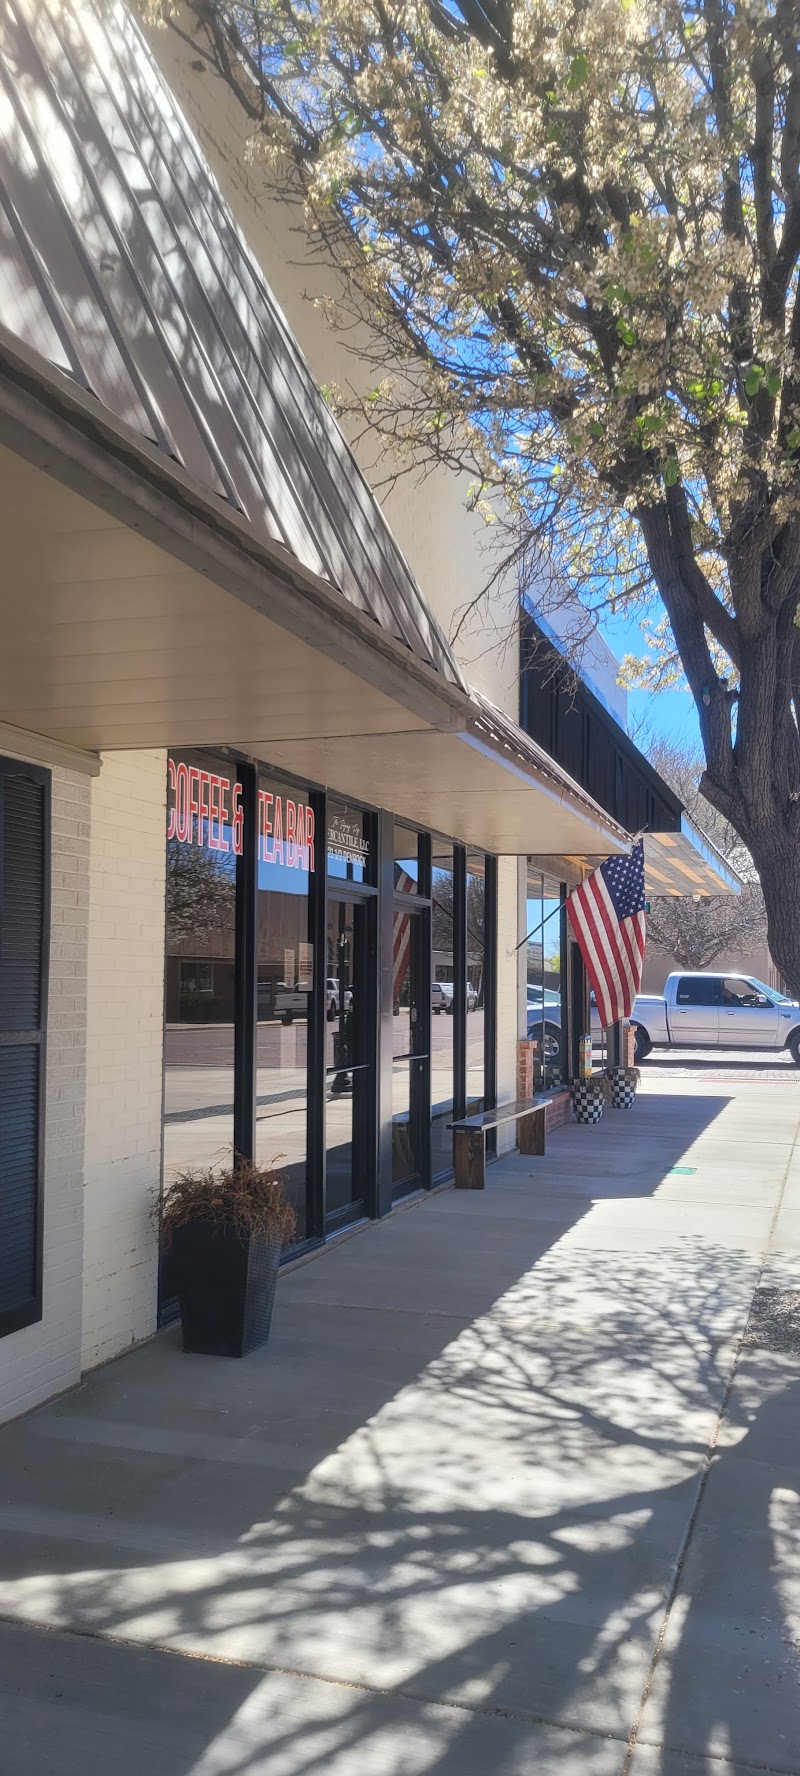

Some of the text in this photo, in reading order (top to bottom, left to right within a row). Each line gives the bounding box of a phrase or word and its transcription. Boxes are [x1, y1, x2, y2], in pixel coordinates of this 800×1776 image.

[167, 758, 230, 852] COFFEE
[232, 783, 244, 856] &
[286, 799, 315, 873] BAR
[359, 839, 369, 851] LLC
